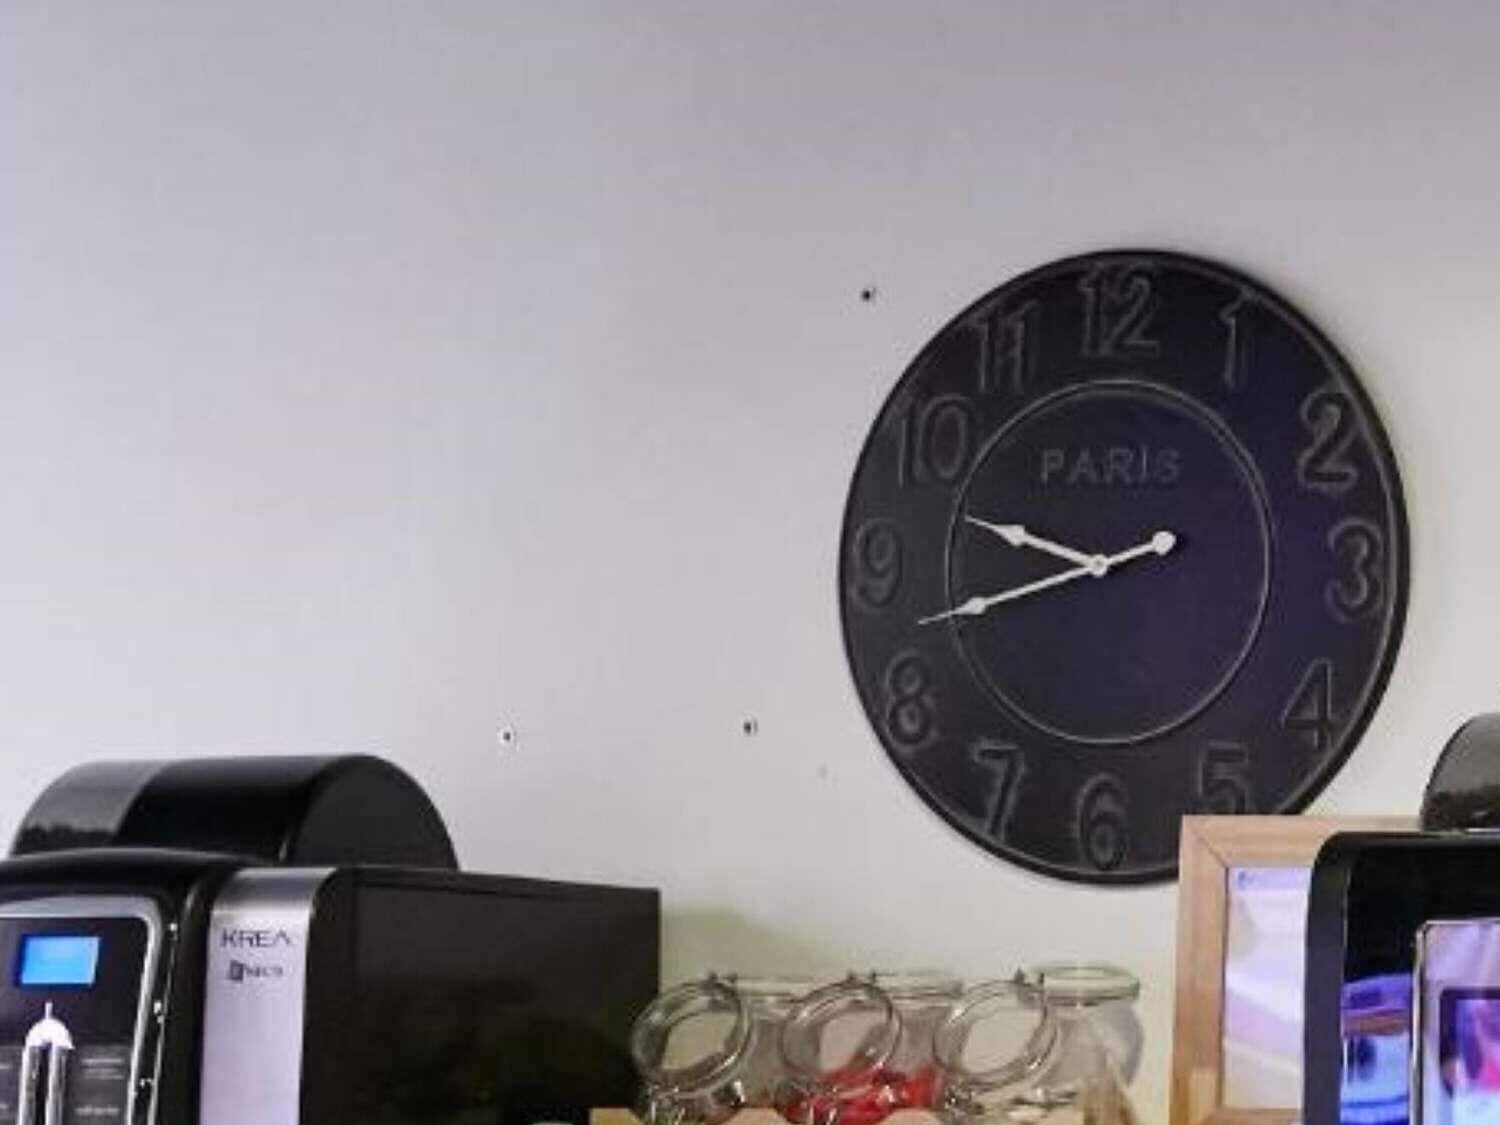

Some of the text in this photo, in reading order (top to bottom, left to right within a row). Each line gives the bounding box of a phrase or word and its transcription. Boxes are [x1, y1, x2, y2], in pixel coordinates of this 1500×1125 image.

[975, 304, 1032, 396] 11
[1078, 262, 1160, 361] 12
[1218, 301, 1248, 390] 1
[897, 394, 970, 487] 10
[1038, 446, 1182, 488] PARIS
[1298, 390, 1360, 495] 2
[850, 516, 903, 612] 9
[1323, 516, 1384, 624] 3
[884, 650, 937, 752] 8
[1278, 655, 1336, 758] 4
[972, 741, 1026, 842] 7
[1074, 772, 1130, 874] 6
[1198, 740, 1253, 815] 5
[219, 927, 292, 948] KREA
